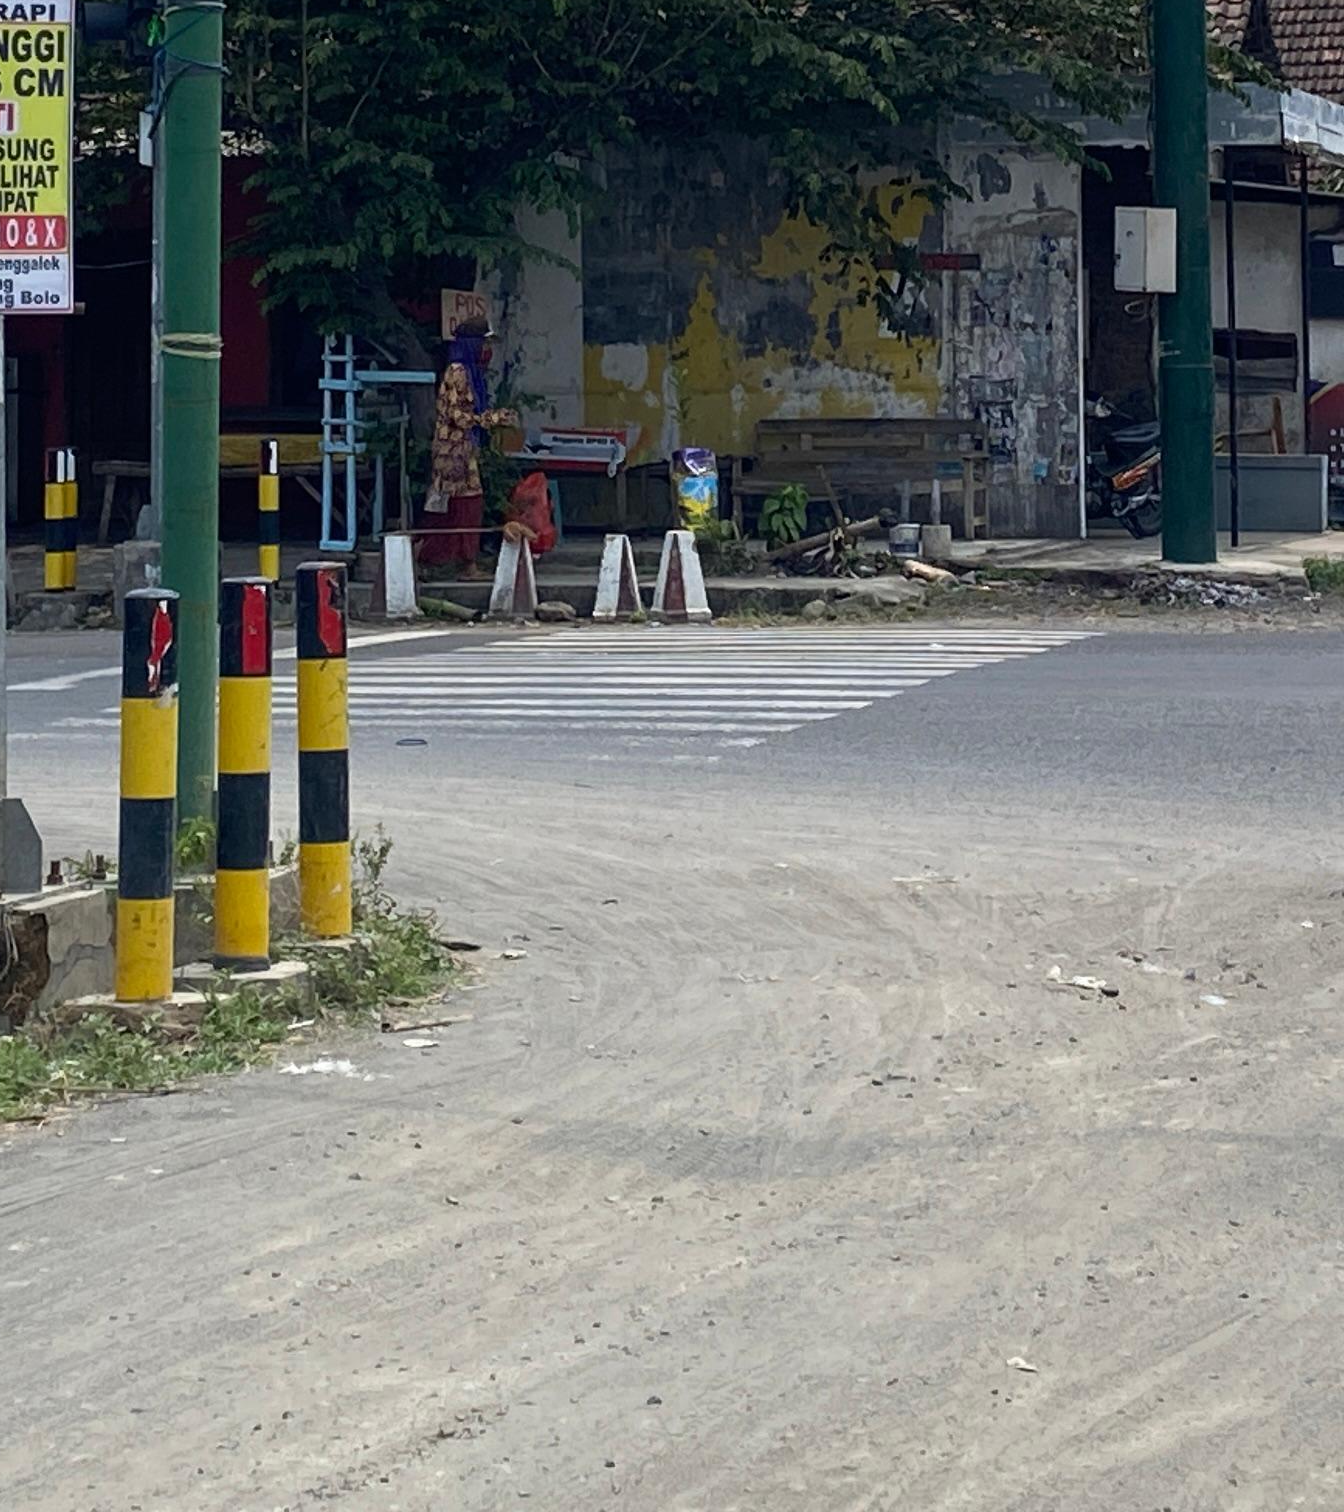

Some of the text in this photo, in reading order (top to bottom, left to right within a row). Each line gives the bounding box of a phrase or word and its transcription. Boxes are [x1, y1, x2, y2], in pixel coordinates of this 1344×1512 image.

[14, 68, 65, 97] CM
[26, 219, 39, 247] &
[44, 219, 58, 248] X
[21, 291, 60, 305] Bolo
